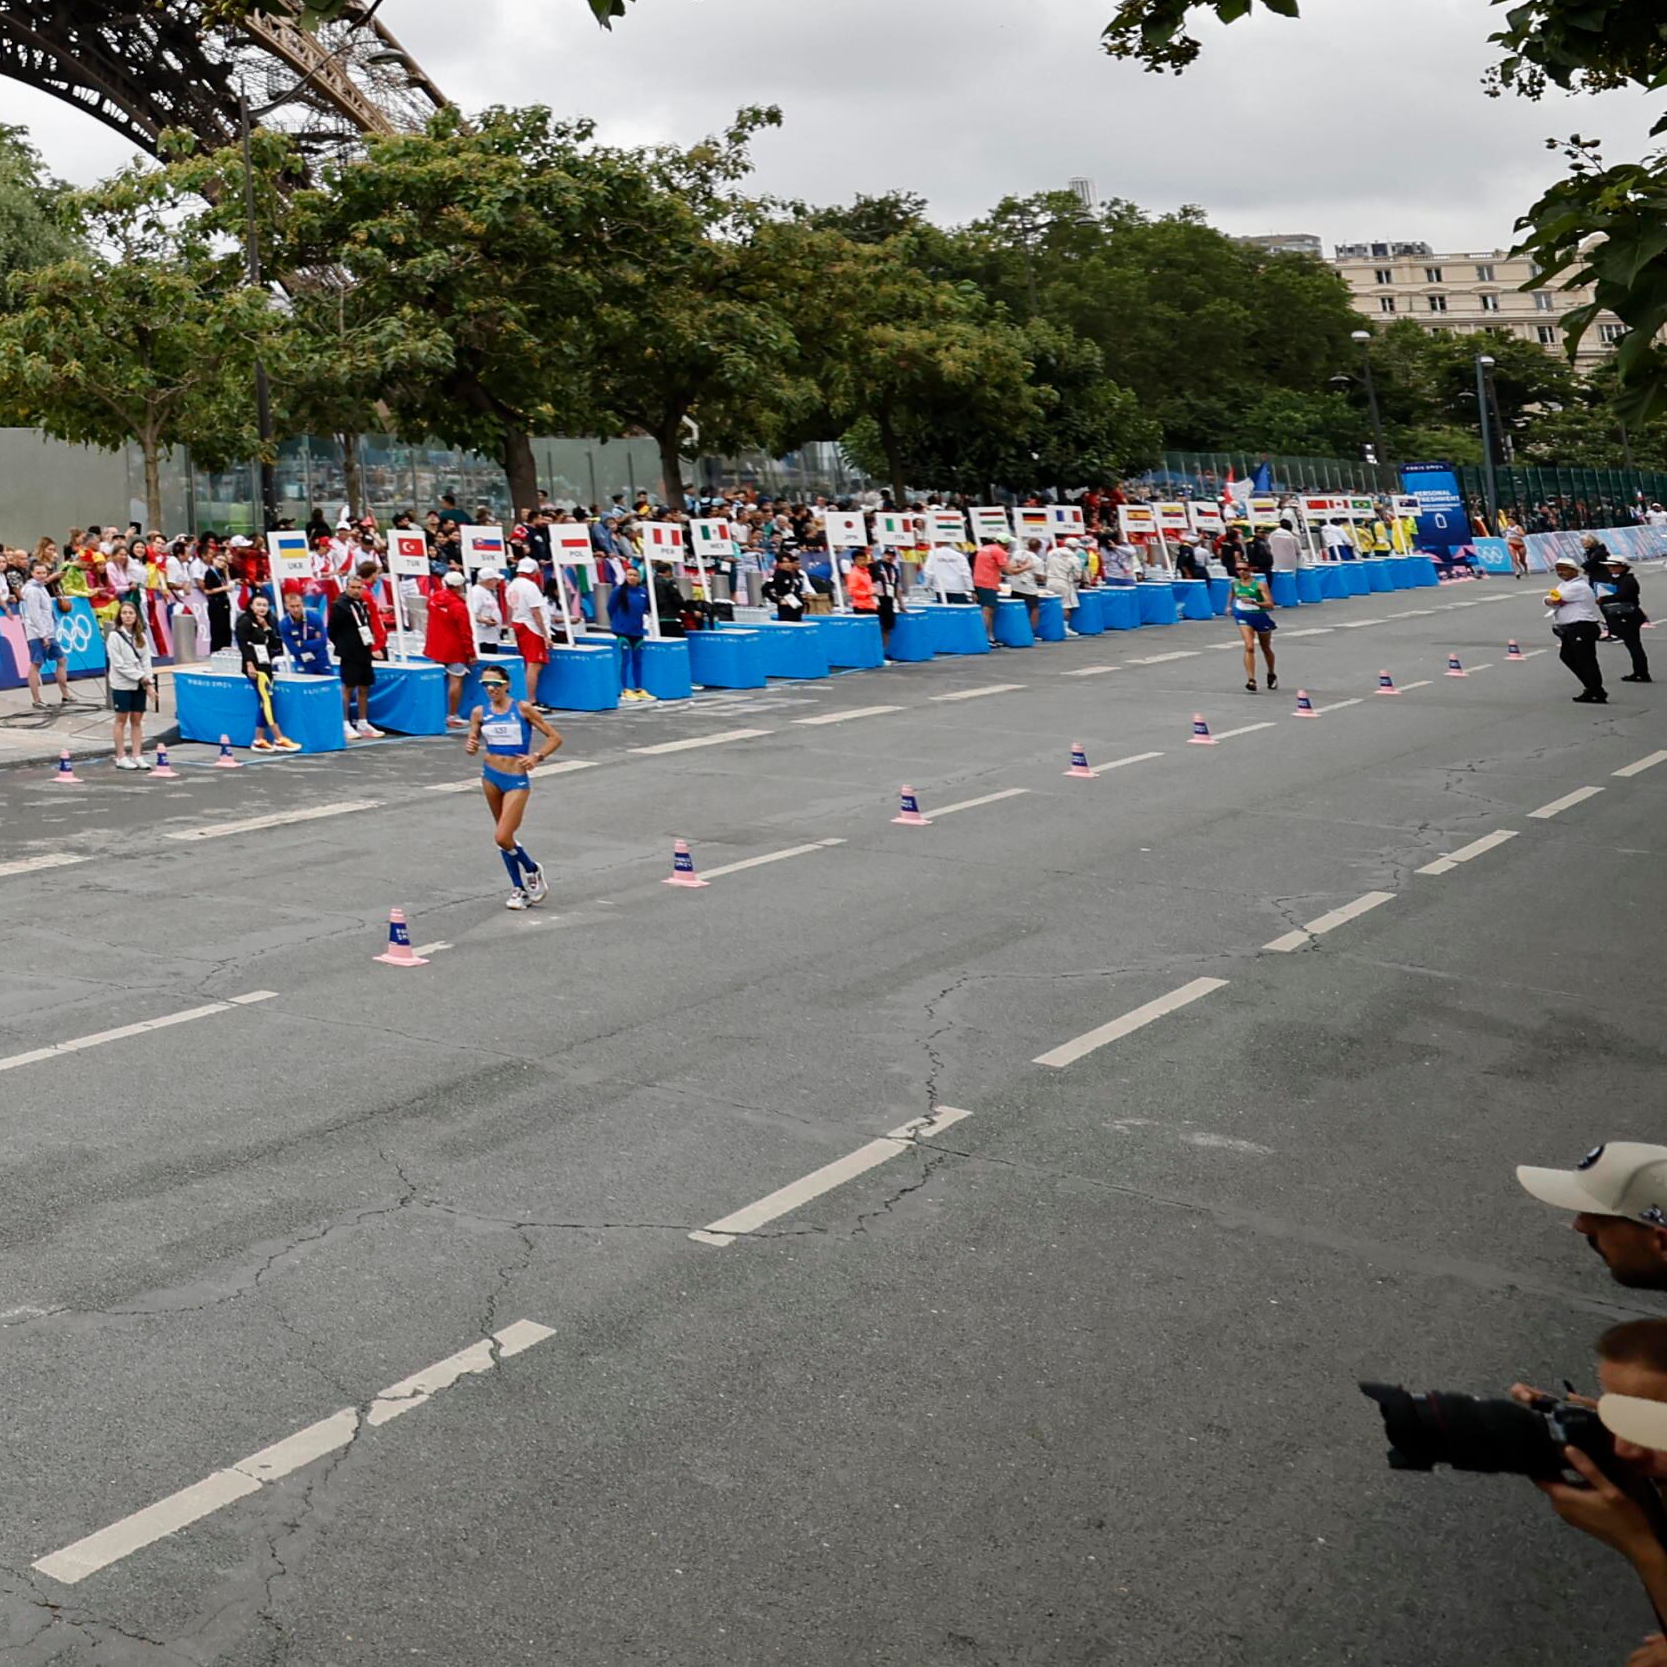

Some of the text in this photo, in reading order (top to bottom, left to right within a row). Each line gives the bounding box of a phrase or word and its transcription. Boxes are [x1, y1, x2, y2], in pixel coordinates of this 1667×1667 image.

[569, 550, 584, 558] POL
[287, 562, 304, 570] UKR
[405, 559, 421, 567] TUR
